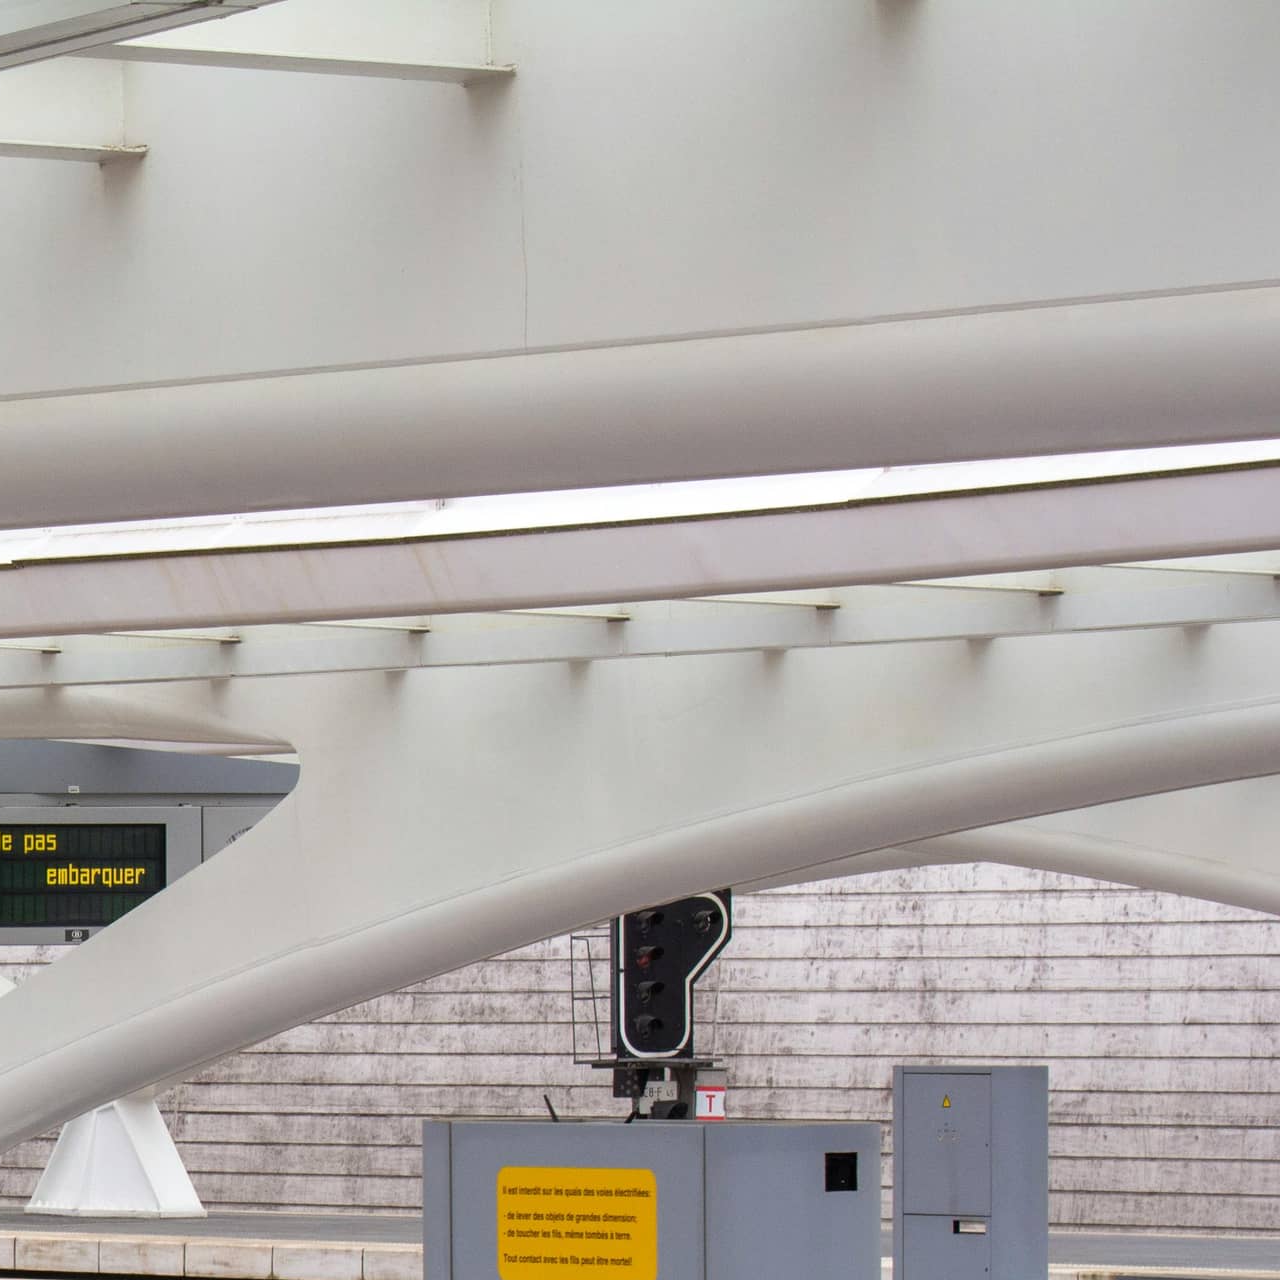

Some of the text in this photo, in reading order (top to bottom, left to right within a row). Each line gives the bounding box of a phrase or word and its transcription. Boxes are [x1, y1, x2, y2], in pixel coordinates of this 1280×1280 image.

[24, 834, 57, 854] pas
[46, 863, 145, 888] embarquer
[705, 1094, 716, 1113] T
[503, 1252, 518, 1263] Tout
